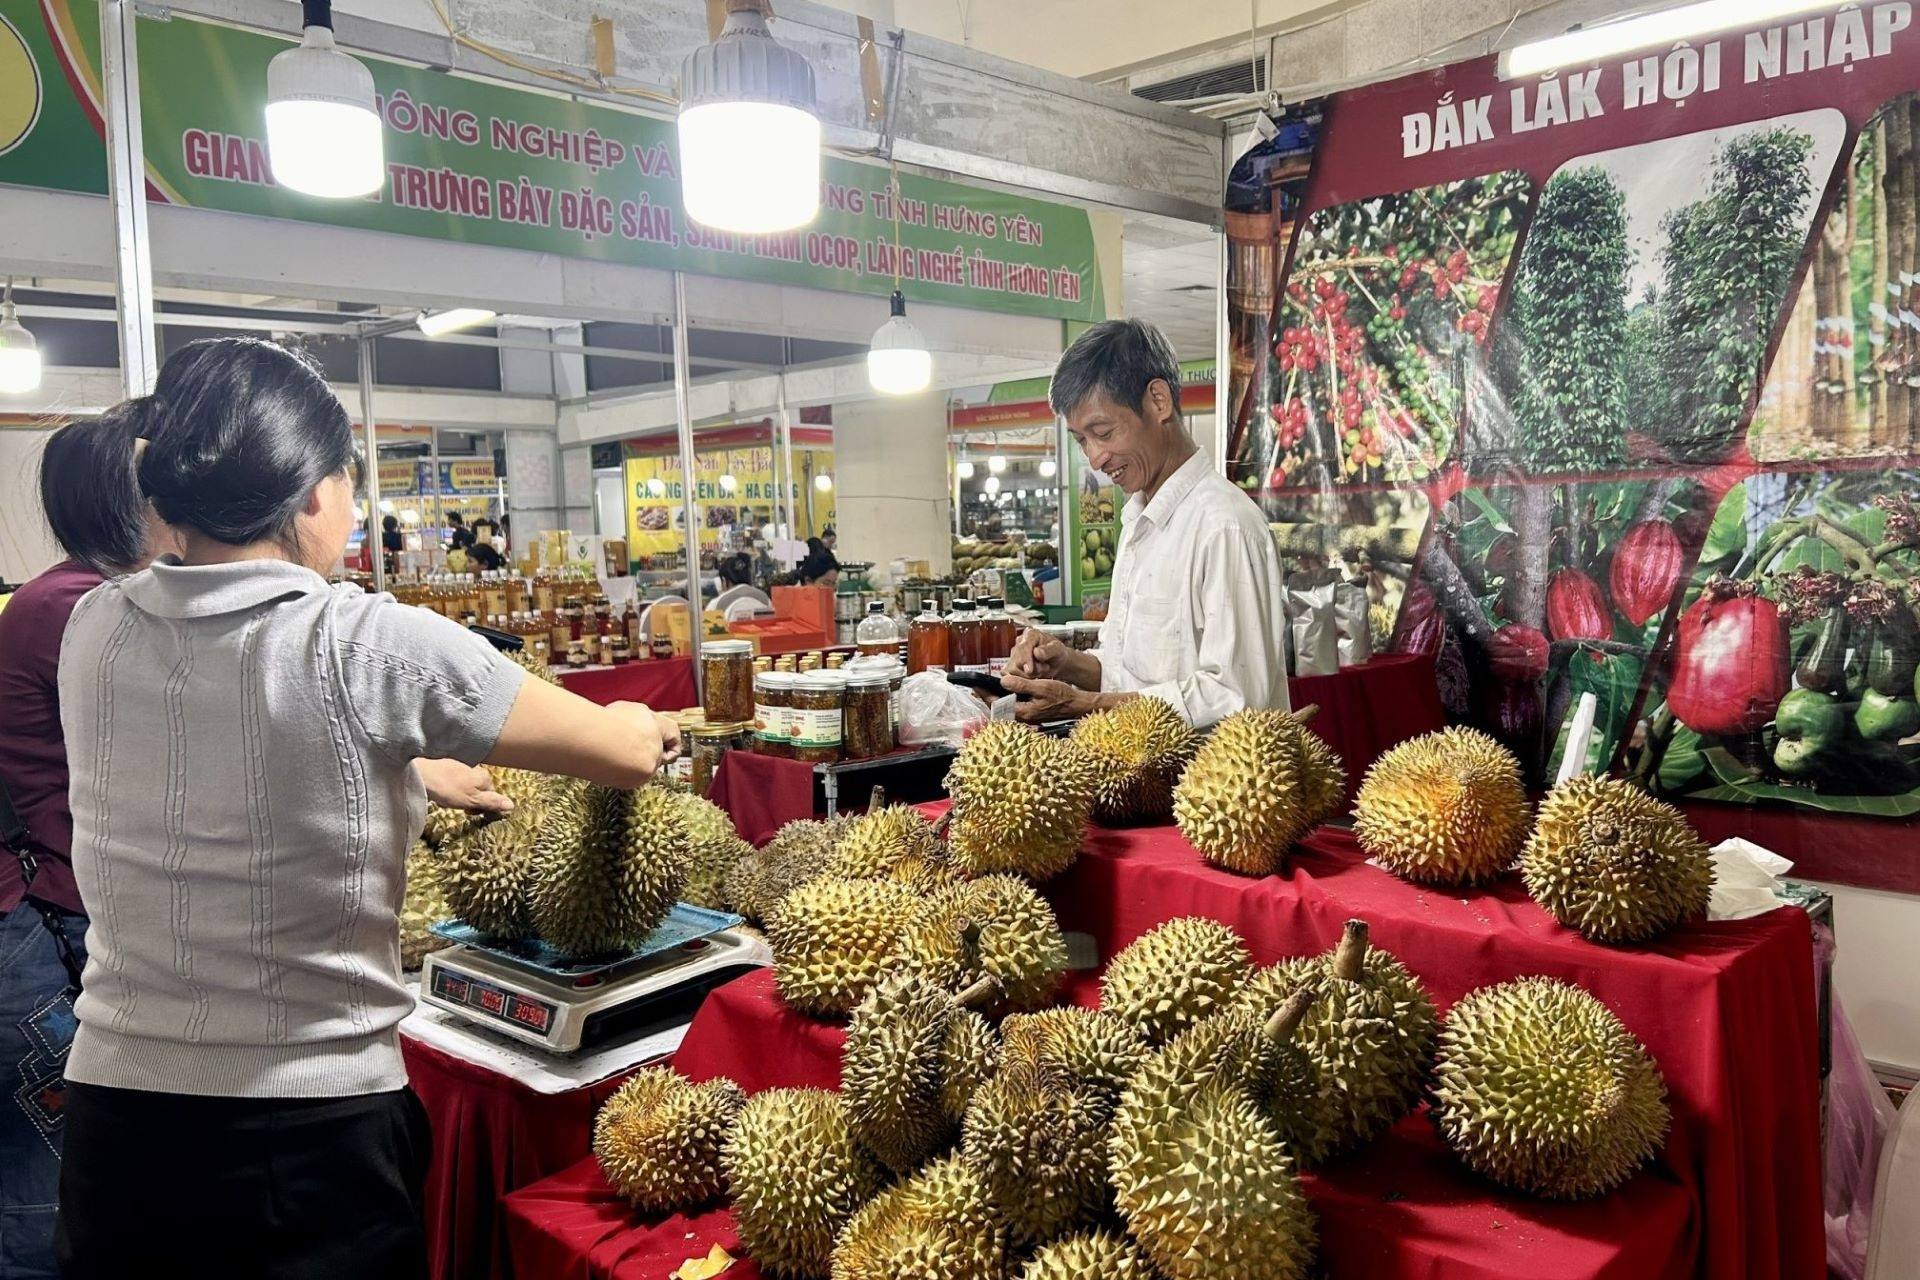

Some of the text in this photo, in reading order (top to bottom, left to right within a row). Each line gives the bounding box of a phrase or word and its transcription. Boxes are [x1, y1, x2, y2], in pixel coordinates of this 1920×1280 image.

[1401, 90, 1495, 158] ĐẮK
[1622, 40, 1721, 109] HỘI
[1744, 3, 1911, 83] NHẬP
[491, 117, 625, 173] NGHIỆP
[634, 143, 676, 179] VÀ
[388, 164, 492, 218] TRƯNG
[498, 176, 553, 227] BÀY
[560, 187, 613, 241] ĐẶC
[620, 192, 679, 248] SẢN,
[807, 232, 862, 274] OCOP,
[866, 236, 916, 279] LÀNG
[917, 246, 964, 286] NGHỀ
[967, 249, 1004, 290] TỈNH
[1008, 263, 1049, 297] HƯNG
[1052, 266, 1080, 302] YÊN
[870, 185, 927, 226] TỈNH
[934, 203, 996, 238] HƯNG
[1002, 215, 1042, 246] YÊN
